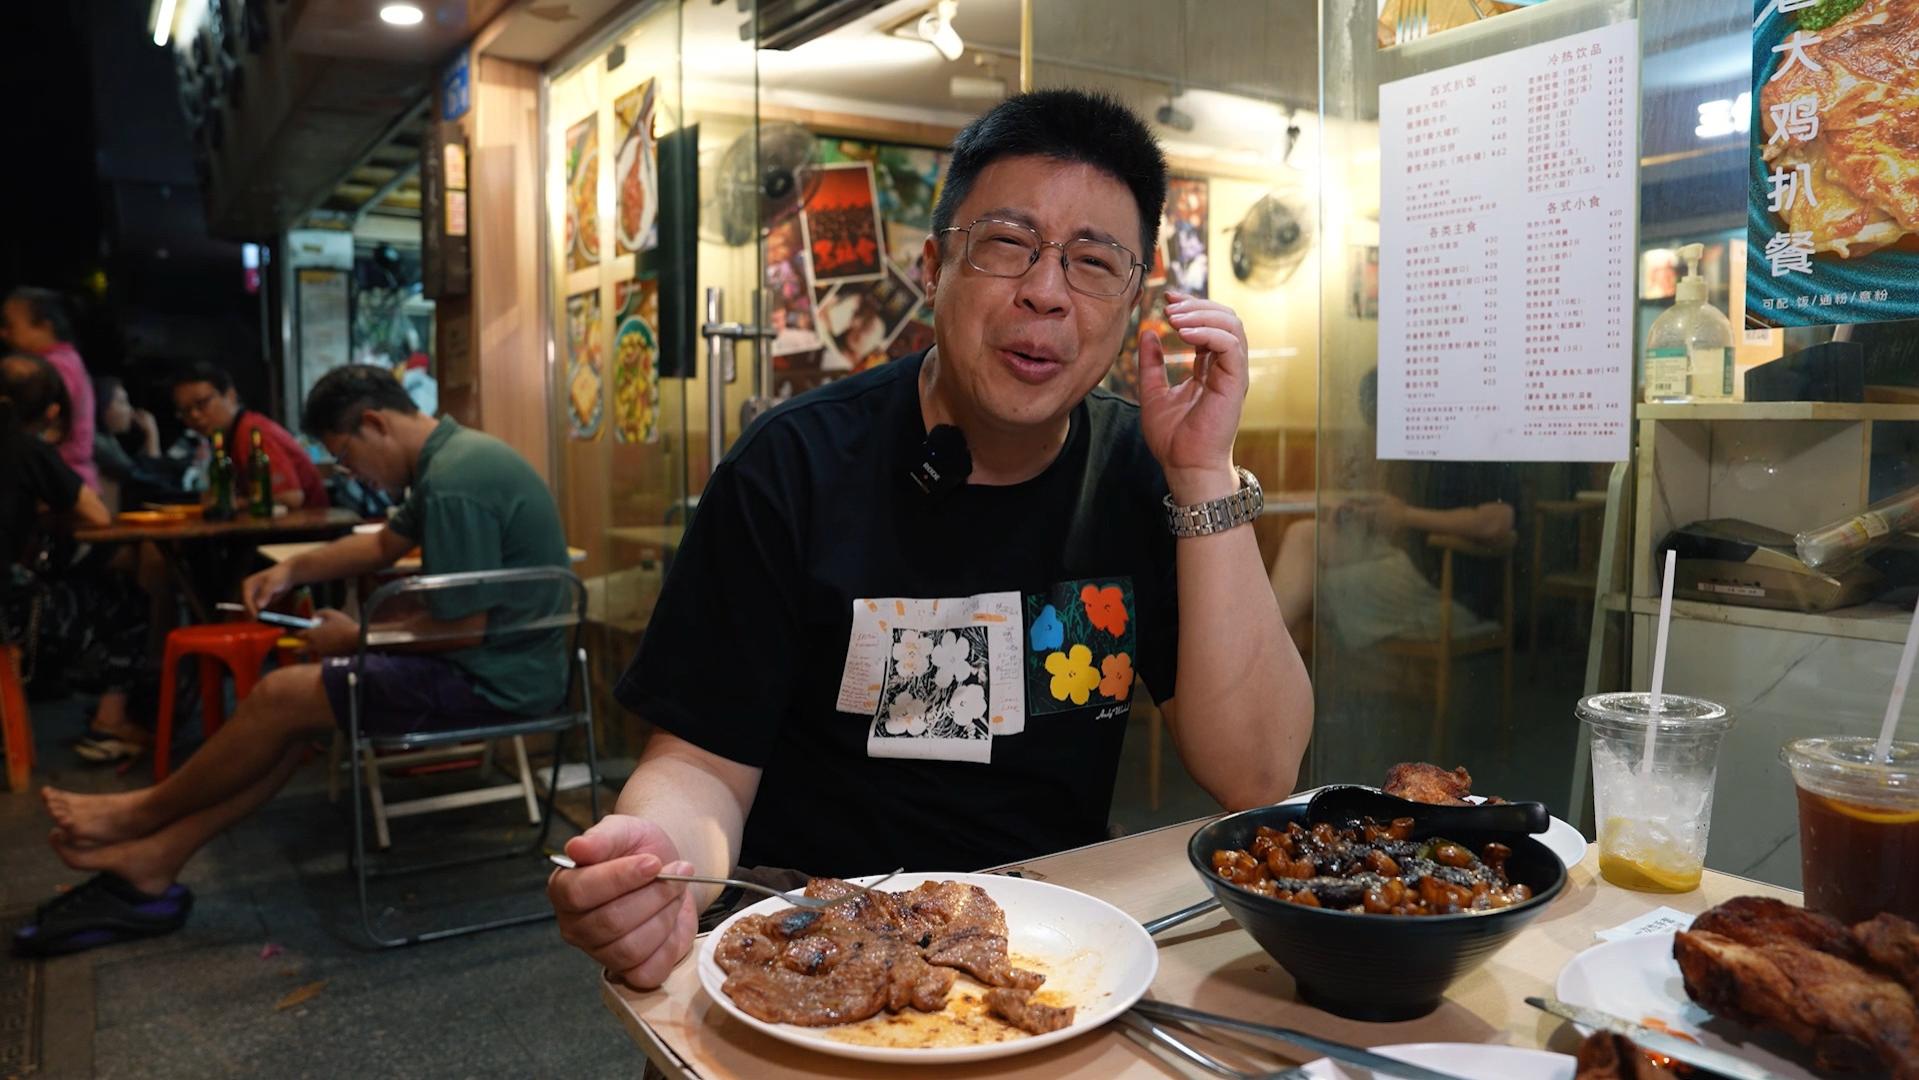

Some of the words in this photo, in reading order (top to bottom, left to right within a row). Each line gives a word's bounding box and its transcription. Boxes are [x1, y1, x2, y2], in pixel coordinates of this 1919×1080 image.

[1547, 43, 1602, 66] 冷热饮品
[1548, 195, 1600, 214] 各式小食
[1430, 221, 1476, 238] 各类主食
[1762, 298, 1789, 310] 可配
[1797, 289, 1889, 308] 饭/通粉/意粉
